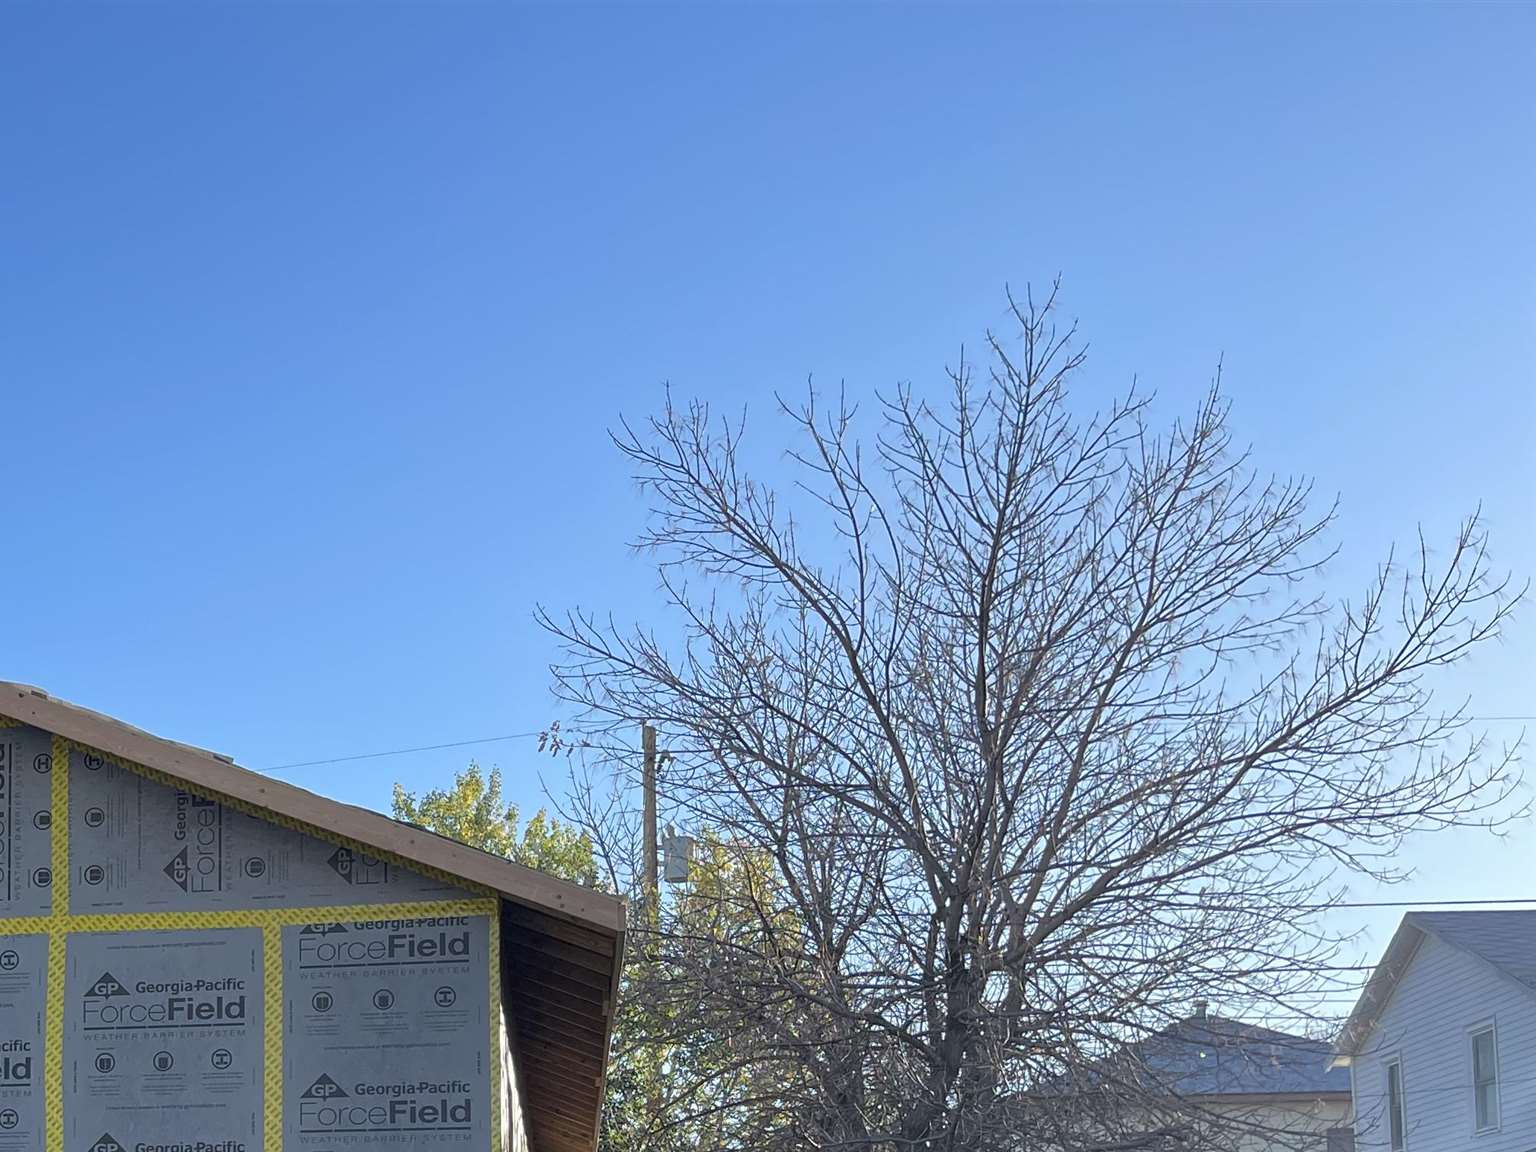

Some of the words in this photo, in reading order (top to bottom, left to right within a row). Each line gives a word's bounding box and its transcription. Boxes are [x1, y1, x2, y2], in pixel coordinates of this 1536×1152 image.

[299, 933, 470, 961] ForceField
[136, 978, 245, 995] Georgia-Pacific
[83, 997, 245, 1024] ForceField
[354, 1080, 470, 1098] Georgia-Pacific
[300, 1099, 471, 1127] ForceField
